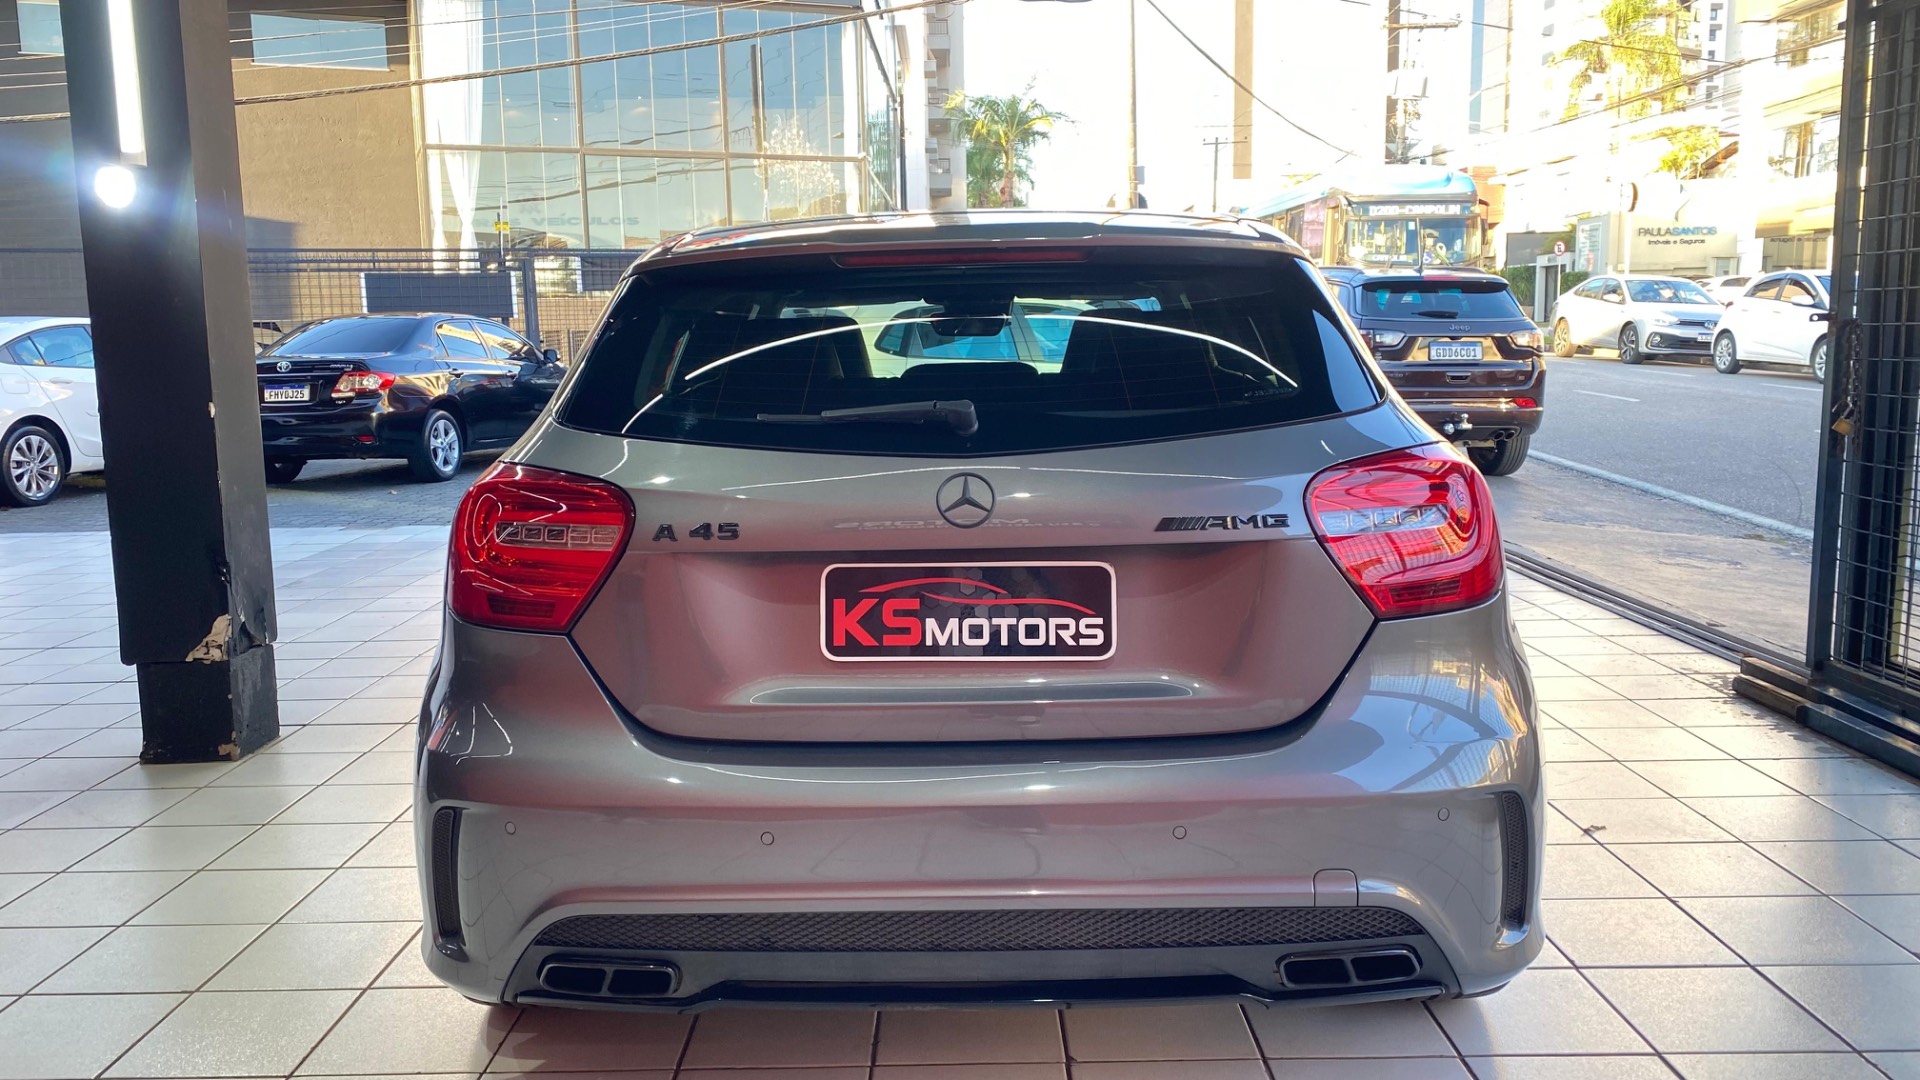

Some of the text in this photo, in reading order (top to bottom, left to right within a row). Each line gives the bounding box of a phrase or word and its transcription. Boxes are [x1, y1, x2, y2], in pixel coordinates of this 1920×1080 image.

[1449, 324, 1471, 332] Jeep
[1200, 513, 1291, 530] AMG
[652, 522, 739, 541] A 45
[832, 598, 1105, 646] KS MOTORS
